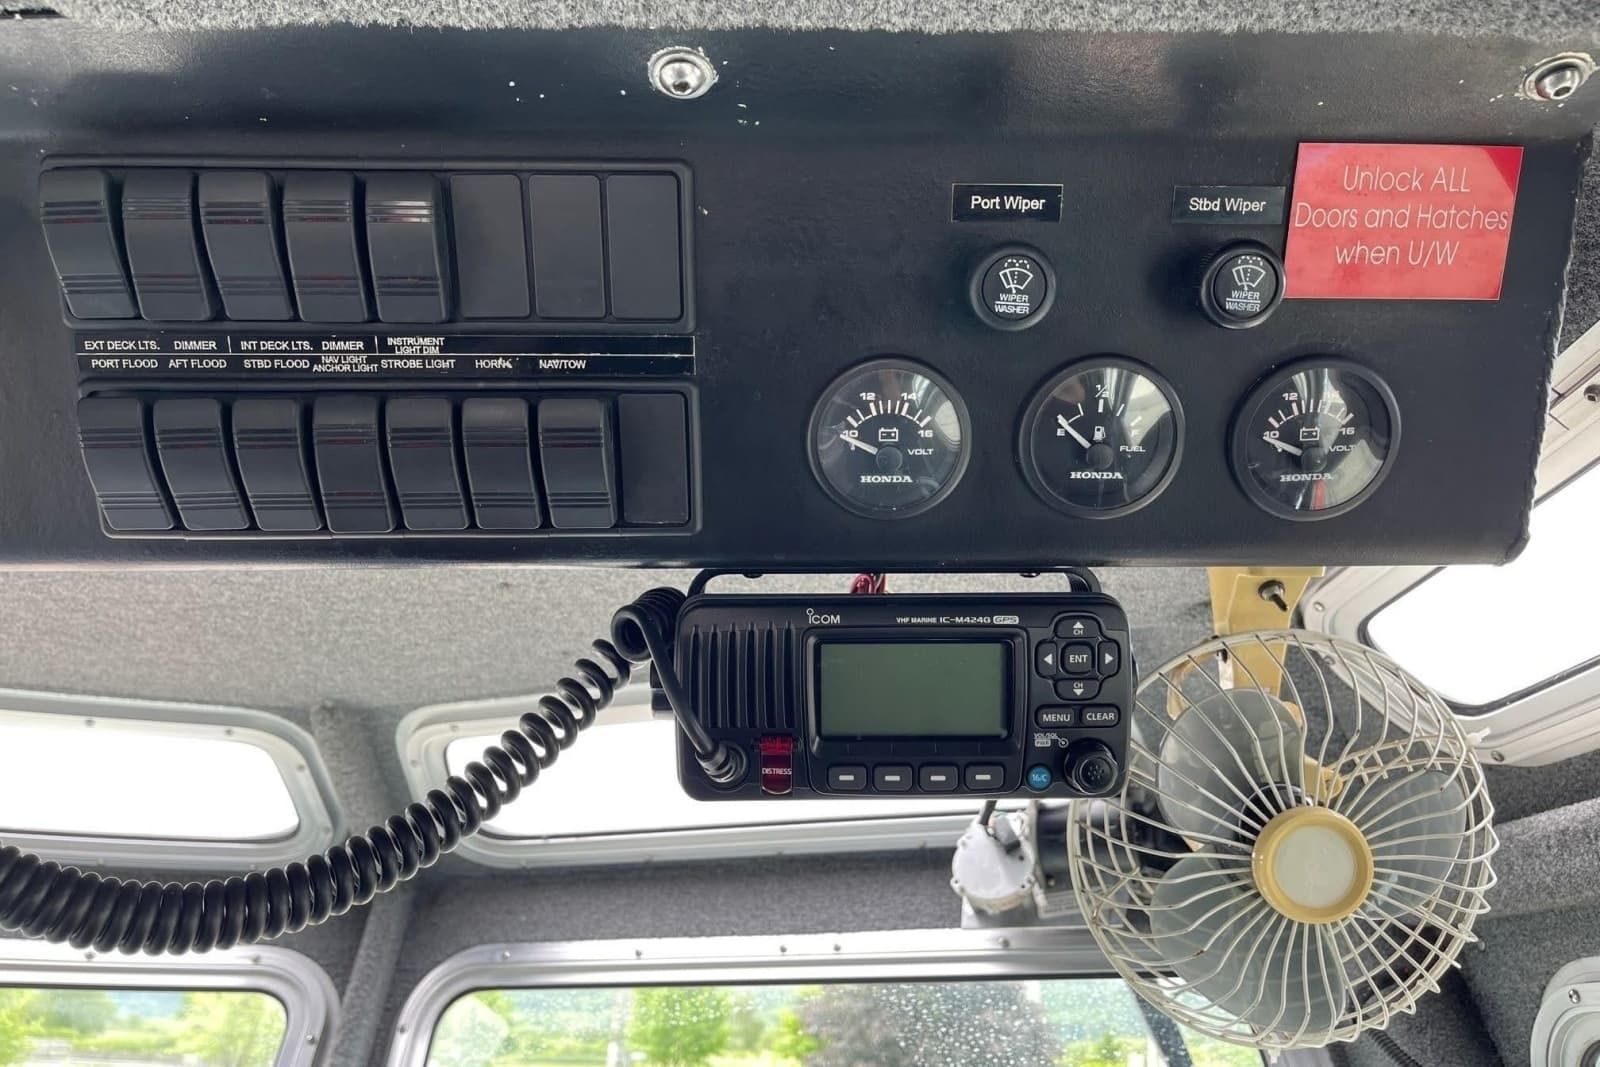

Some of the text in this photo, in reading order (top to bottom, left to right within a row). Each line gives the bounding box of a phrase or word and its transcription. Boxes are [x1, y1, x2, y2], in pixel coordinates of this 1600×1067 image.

[1343, 165, 1471, 193] Unlock ALL
[970, 195, 1046, 212] Port Wiper
[1188, 197, 1266, 214] Stbd Wiper
[1295, 202, 1508, 230] Doors and Hatches
[1335, 240, 1460, 268] when U/W
[999, 293, 1029, 303] WIPER
[1231, 290, 1260, 300] WIPER
[994, 304, 1030, 315] WASHER
[1225, 301, 1261, 313] WASHER
[84, 340, 161, 351] EXT DECK LTS.
[174, 341, 217, 351] DIMMER
[240, 340, 314, 351] INT DECK LTS.
[321, 341, 364, 351] DIMMER
[387, 337, 445, 346] INSTRUMENT
[395, 346, 440, 354] LIGHT DIM
[91, 359, 159, 369] PORT FLOOD
[168, 359, 227, 369] AFT FLOOD
[243, 359, 310, 369] STBD FLOOD
[321, 355, 368, 364] NAV LIGHT
[380, 359, 456, 370] STROBE LIGHT
[312, 363, 378, 373] ANCHOR LIGHT
[859, 392, 876, 401] 12
[900, 392, 917, 401] 14
[1282, 392, 1298, 401] 12
[918, 430, 933, 438] 16
[1056, 428, 1066, 437] E
[1340, 427, 1355, 436] 16
[907, 448, 934, 456] VOLT
[1119, 445, 1146, 453] FUEL
[1328, 445, 1355, 453] VOLT
[860, 475, 913, 483] HONDA
[1070, 471, 1123, 480] HONDA
[1280, 473, 1333, 483] HONDA
[993, 615, 1019, 625] GPS
[1069, 654, 1088, 663] ENT
[1042, 713, 1071, 722] MENU
[1086, 712, 1115, 721] CLEAR
[761, 767, 792, 775] DISTRESS
